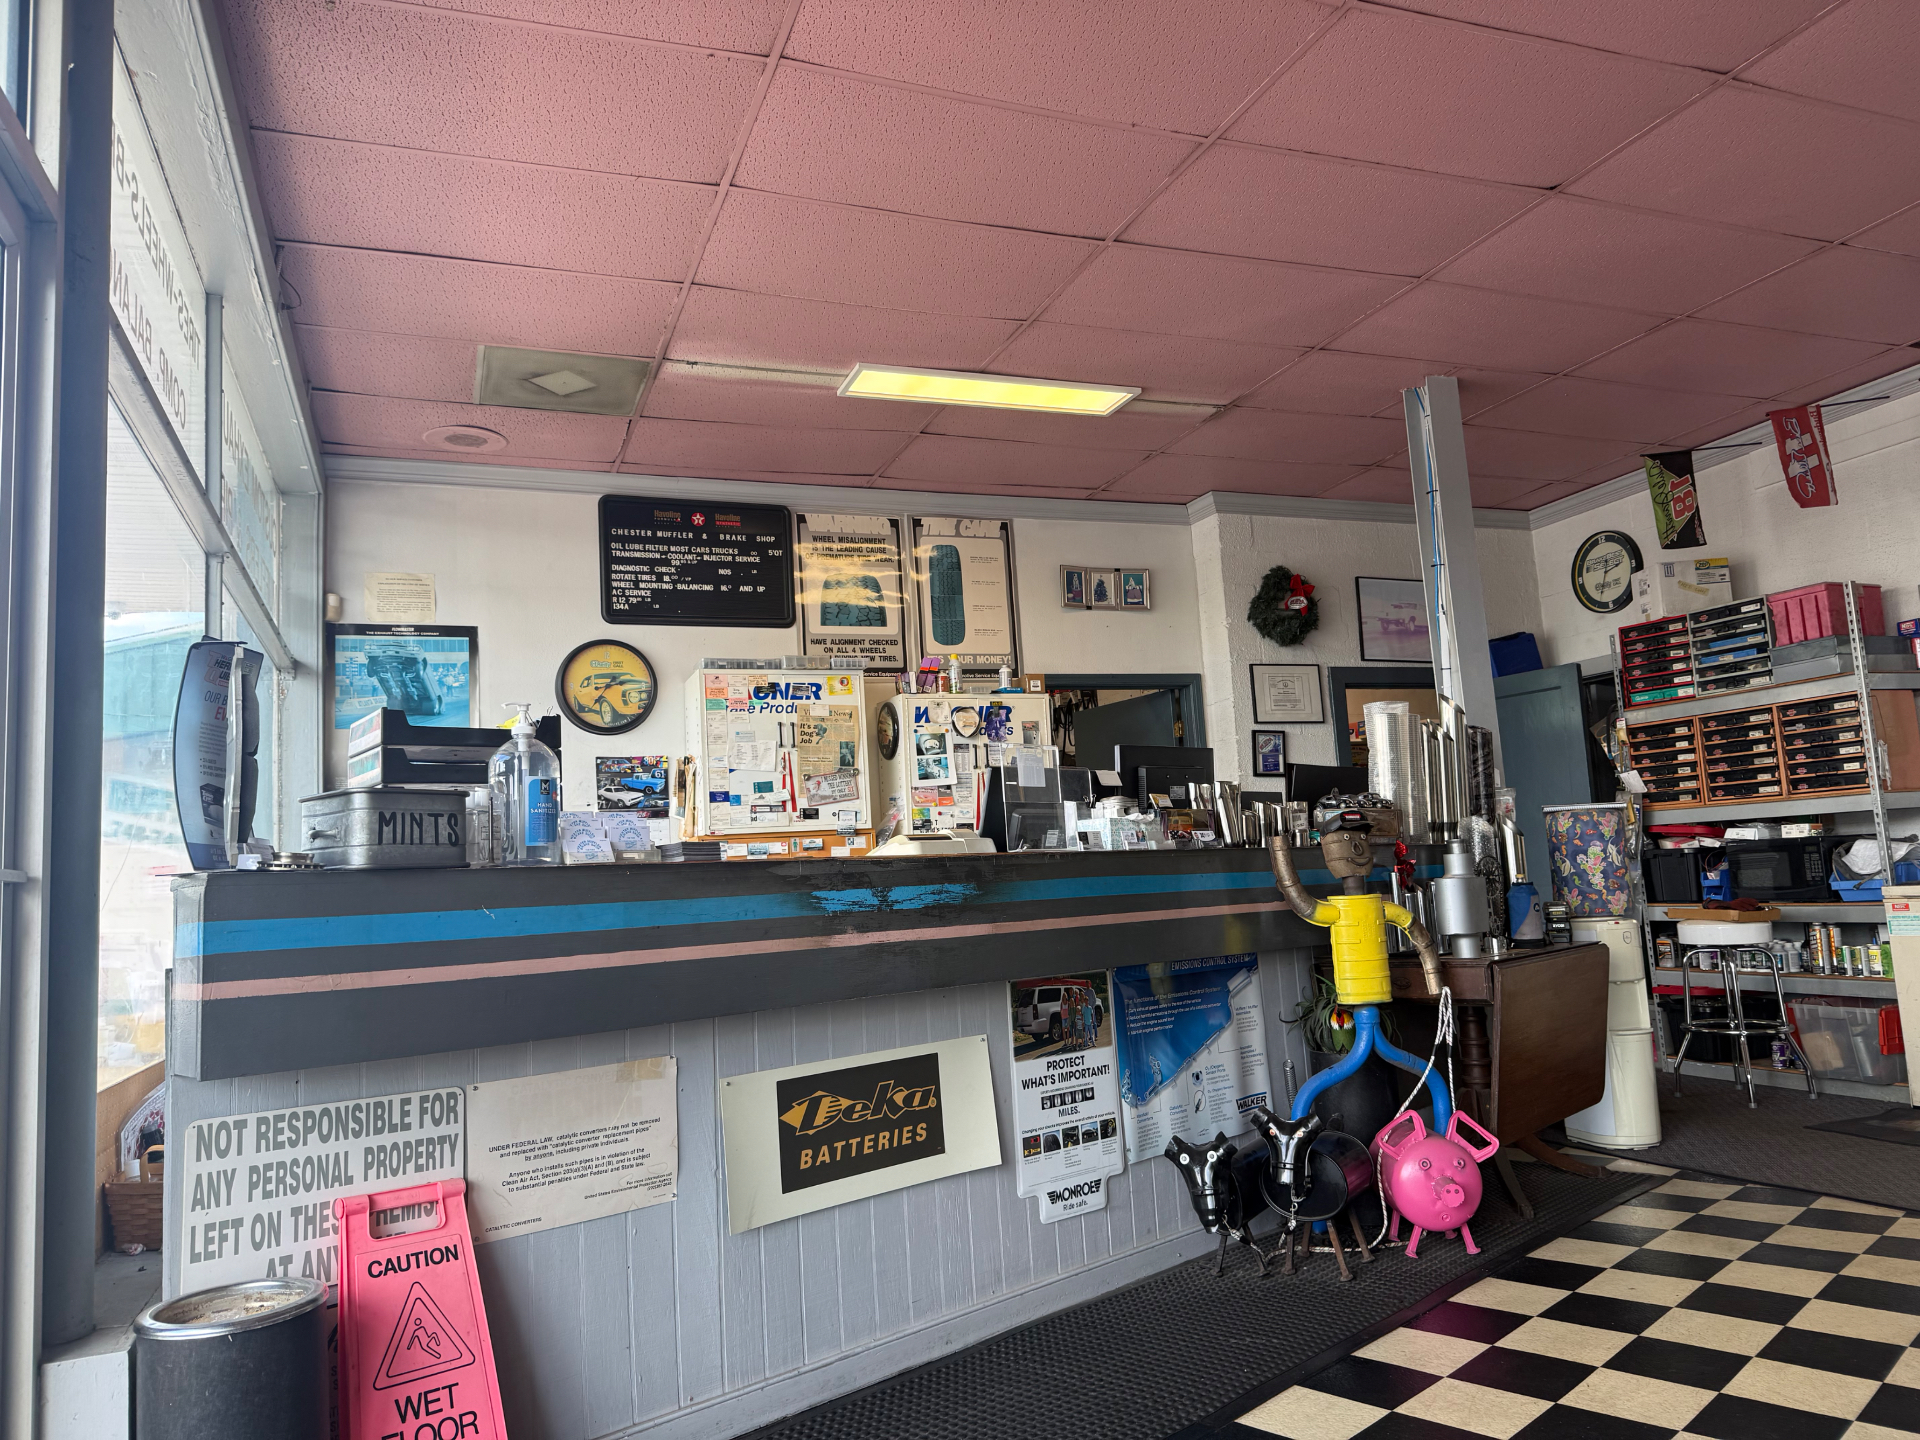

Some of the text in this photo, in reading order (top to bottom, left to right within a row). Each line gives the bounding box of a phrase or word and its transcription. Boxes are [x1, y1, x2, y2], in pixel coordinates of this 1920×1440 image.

[654, 510, 682, 518] Havoline
[714, 513, 740, 521] Havoline
[611, 528, 652, 537] CHESTER
[656, 530, 694, 539] MUFFLER
[720, 534, 747, 542] BRAKE
[812, 535, 886, 545] WHEEL MISALIGNMENT
[1631, 559, 1636, 567] 3
[205, 690, 221, 705] OUR
[542, 781, 549, 790] M
[378, 811, 459, 847] MINTS
[1171, 954, 1249, 971] EMISSIONS CONTROL SYSTEM
[1168, 990, 1189, 999] Emissions
[1046, 1055, 1085, 1071] PROTECT
[1022, 1074, 1056, 1090] WHAT'S
[1058, 1064, 1110, 1084] IMPORTANT!
[792, 1080, 936, 1136] Deka
[1236, 1096, 1267, 1110] WALKER
[196, 1091, 459, 1163] NOT RESPONSIBLE FOR
[488, 1144, 510, 1153] UNDER
[512, 1139, 539, 1148] FEDERAL
[556, 1132, 578, 1140] catalytic
[580, 1127, 607, 1136] converters
[639, 1117, 660, 1126] removed
[512, 1147, 536, 1156] replaced
[575, 1136, 600, 1144] converter
[603, 1129, 635, 1139] replacement
[533, 1151, 554, 1160] anyone,
[556, 1146, 580, 1155] including
[581, 1142, 599, 1151] private
[800, 1123, 928, 1170] BATTERIES
[191, 1132, 459, 1213] ANY PERSONAL PROPERTY
[509, 1170, 530, 1178] Anyone
[607, 1151, 629, 1159] violation
[542, 1170, 562, 1179] Section
[632, 1153, 651, 1161] subject
[516, 1181, 546, 1191] substantial
[548, 1176, 572, 1186] penalties
[590, 1168, 609, 1177] Federal
[611, 1184, 638, 1194] Environmental
[1049, 1180, 1100, 1204] MONROE
[1063, 1201, 1075, 1211] Ride
[190, 1198, 339, 1264] LEFT ON THES
[485, 1217, 542, 1232] CATALYTIC CONVERTERS
[368, 1244, 459, 1278] CAUTION
[395, 1382, 459, 1424] WET
